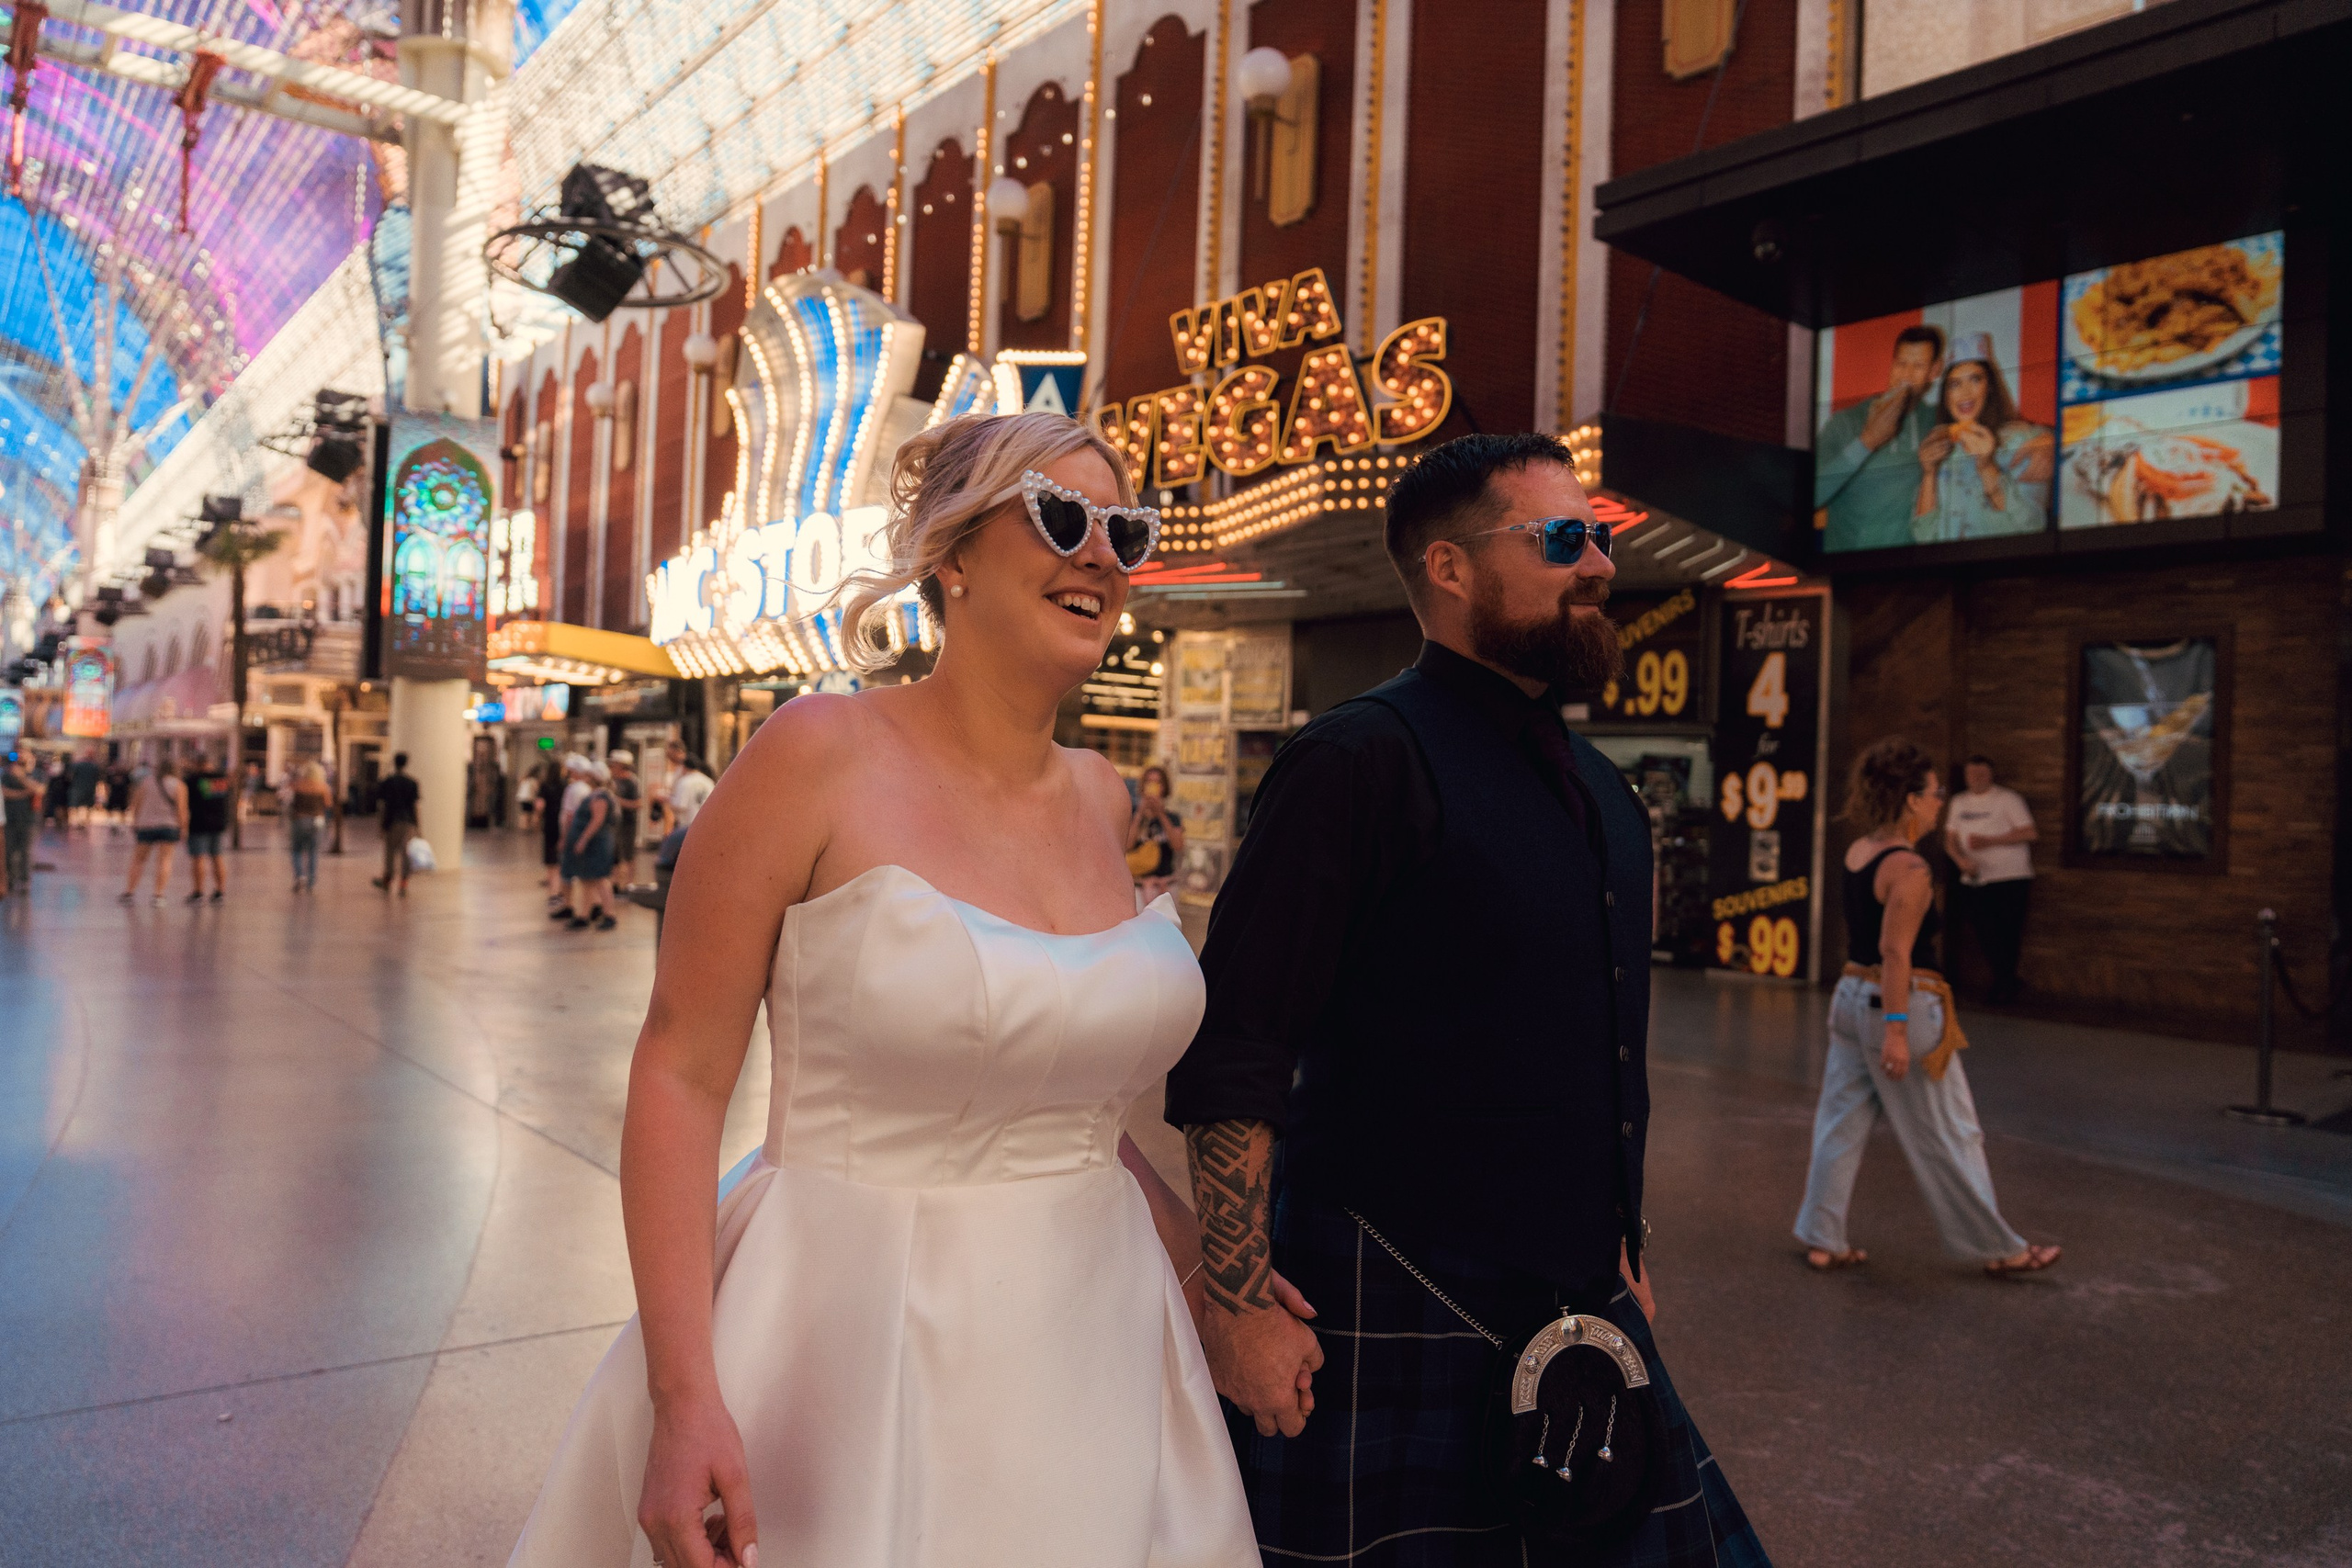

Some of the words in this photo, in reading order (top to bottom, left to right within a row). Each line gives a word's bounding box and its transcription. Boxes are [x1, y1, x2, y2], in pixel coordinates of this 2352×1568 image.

[1169, 266, 1341, 375] VIVA
[1093, 316, 1453, 494] VEGAS
[1736, 602, 1810, 649] T-shirts
[1747, 649, 1790, 728] 4
[1713, 876, 1808, 920] SOUVENIRS
